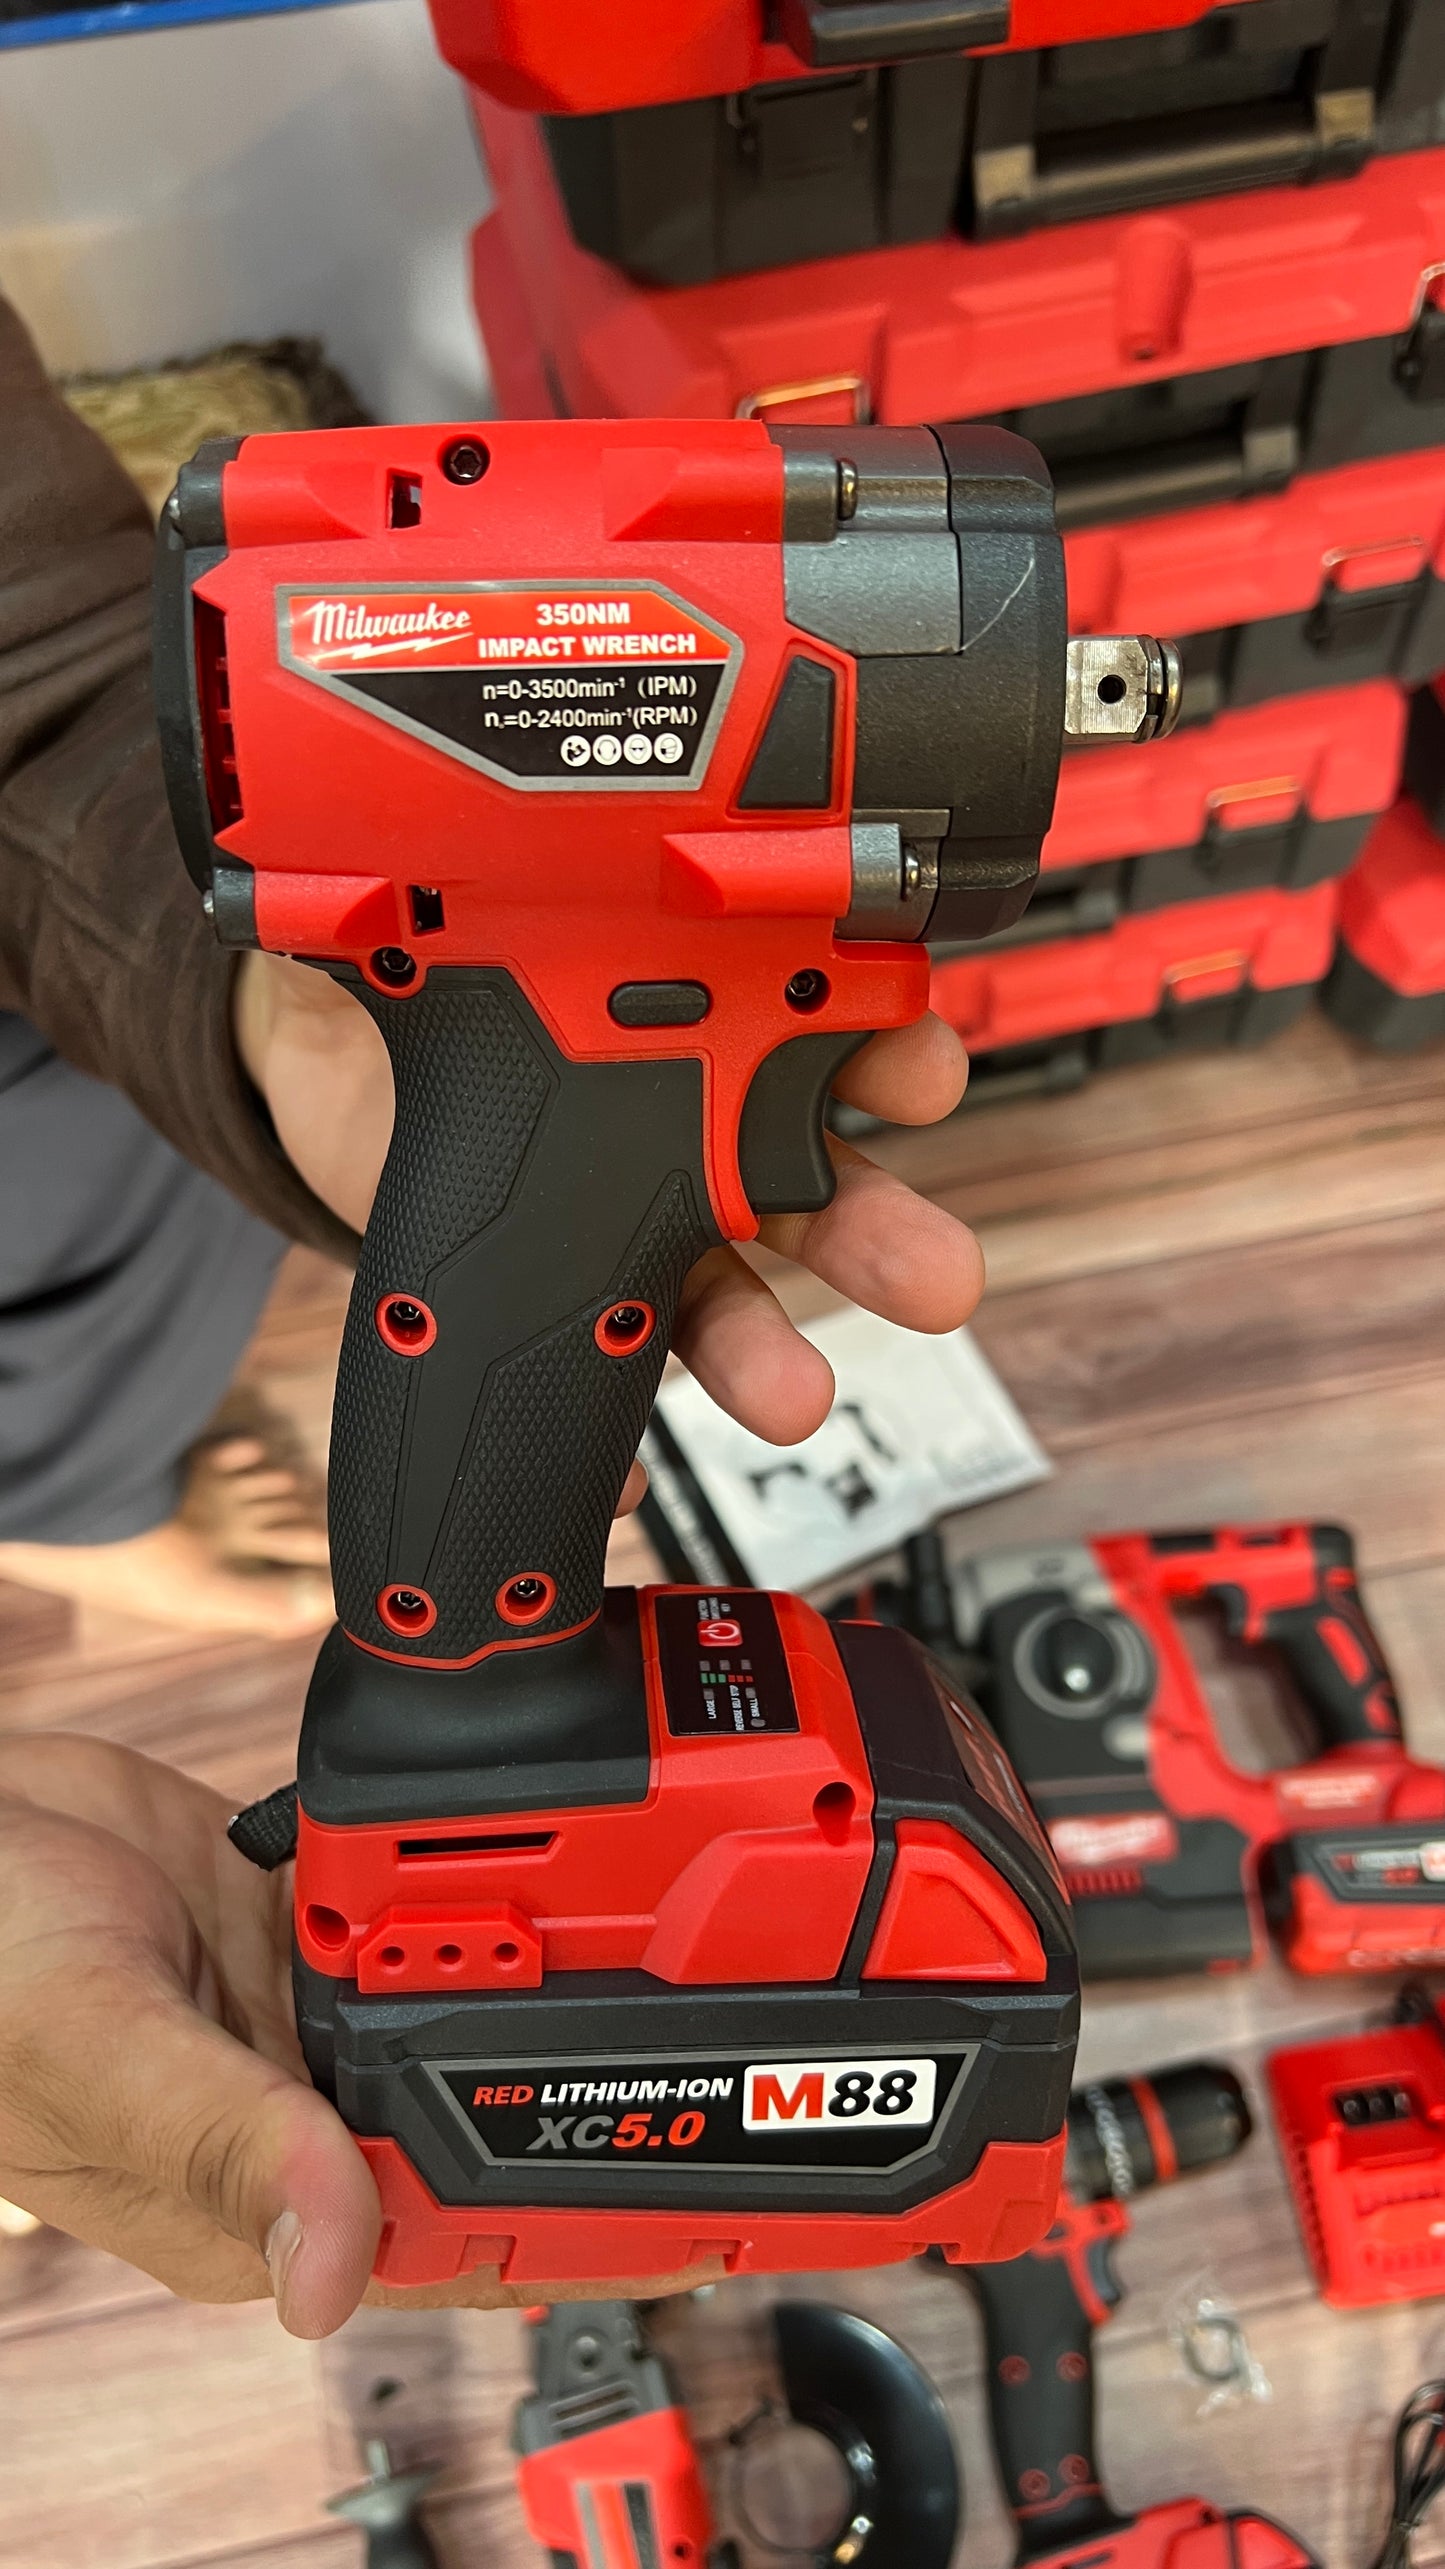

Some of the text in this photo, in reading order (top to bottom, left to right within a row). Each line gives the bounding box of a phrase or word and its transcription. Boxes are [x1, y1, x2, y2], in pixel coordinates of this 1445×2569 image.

[304, 600, 472, 645] Milwaukee
[536, 602, 630, 626] 350NM
[478, 633, 696, 658] IMPACT WRENCH
[637, 675, 698, 699] (IPM)
[473, 2078, 733, 2105] RED LITHIUM-ION
[752, 2070, 917, 2120] M88
[525, 2111, 706, 2150] XC5.0
